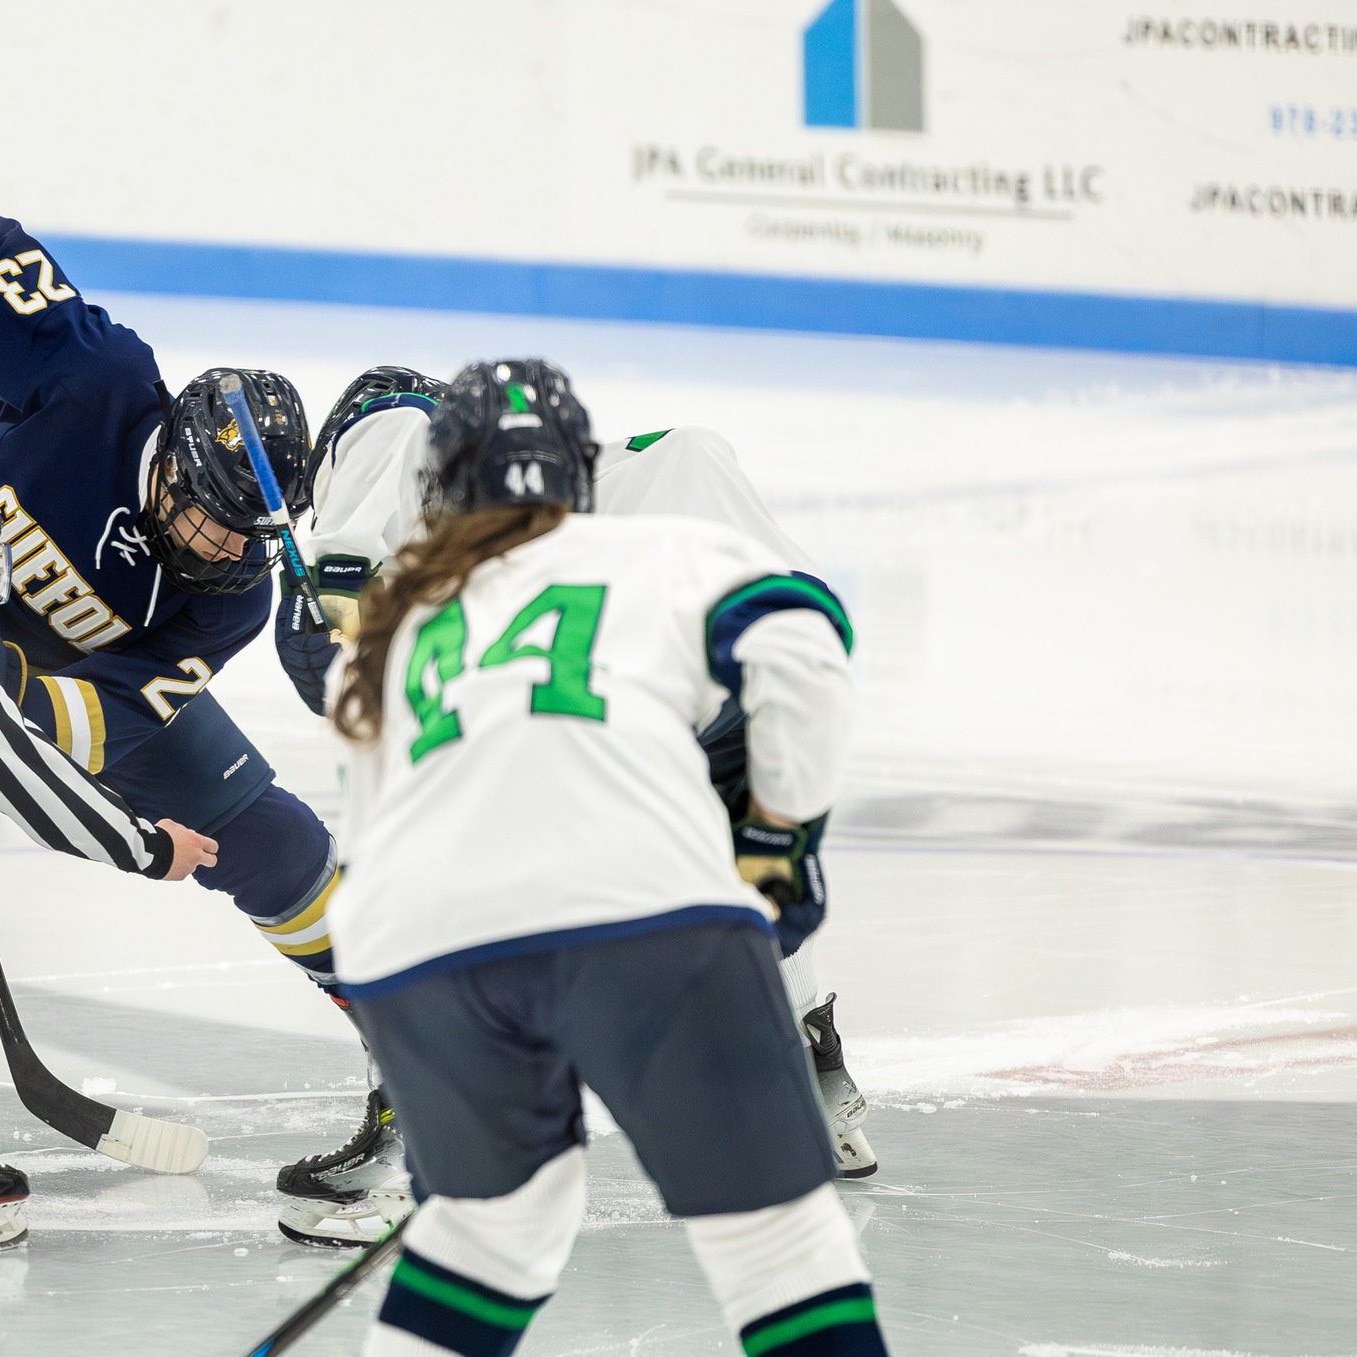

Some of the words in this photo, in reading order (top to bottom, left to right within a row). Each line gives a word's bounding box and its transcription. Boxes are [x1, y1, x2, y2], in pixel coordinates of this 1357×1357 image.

[632, 144, 684, 184] JPA
[696, 147, 826, 184] General
[834, 151, 1031, 207] Contracting
[1043, 164, 1104, 204] LLC
[504, 461, 545, 496] 44
[280, 529, 307, 577] NEXUS
[405, 584, 608, 769] 44
[223, 753, 249, 780] BAUER
